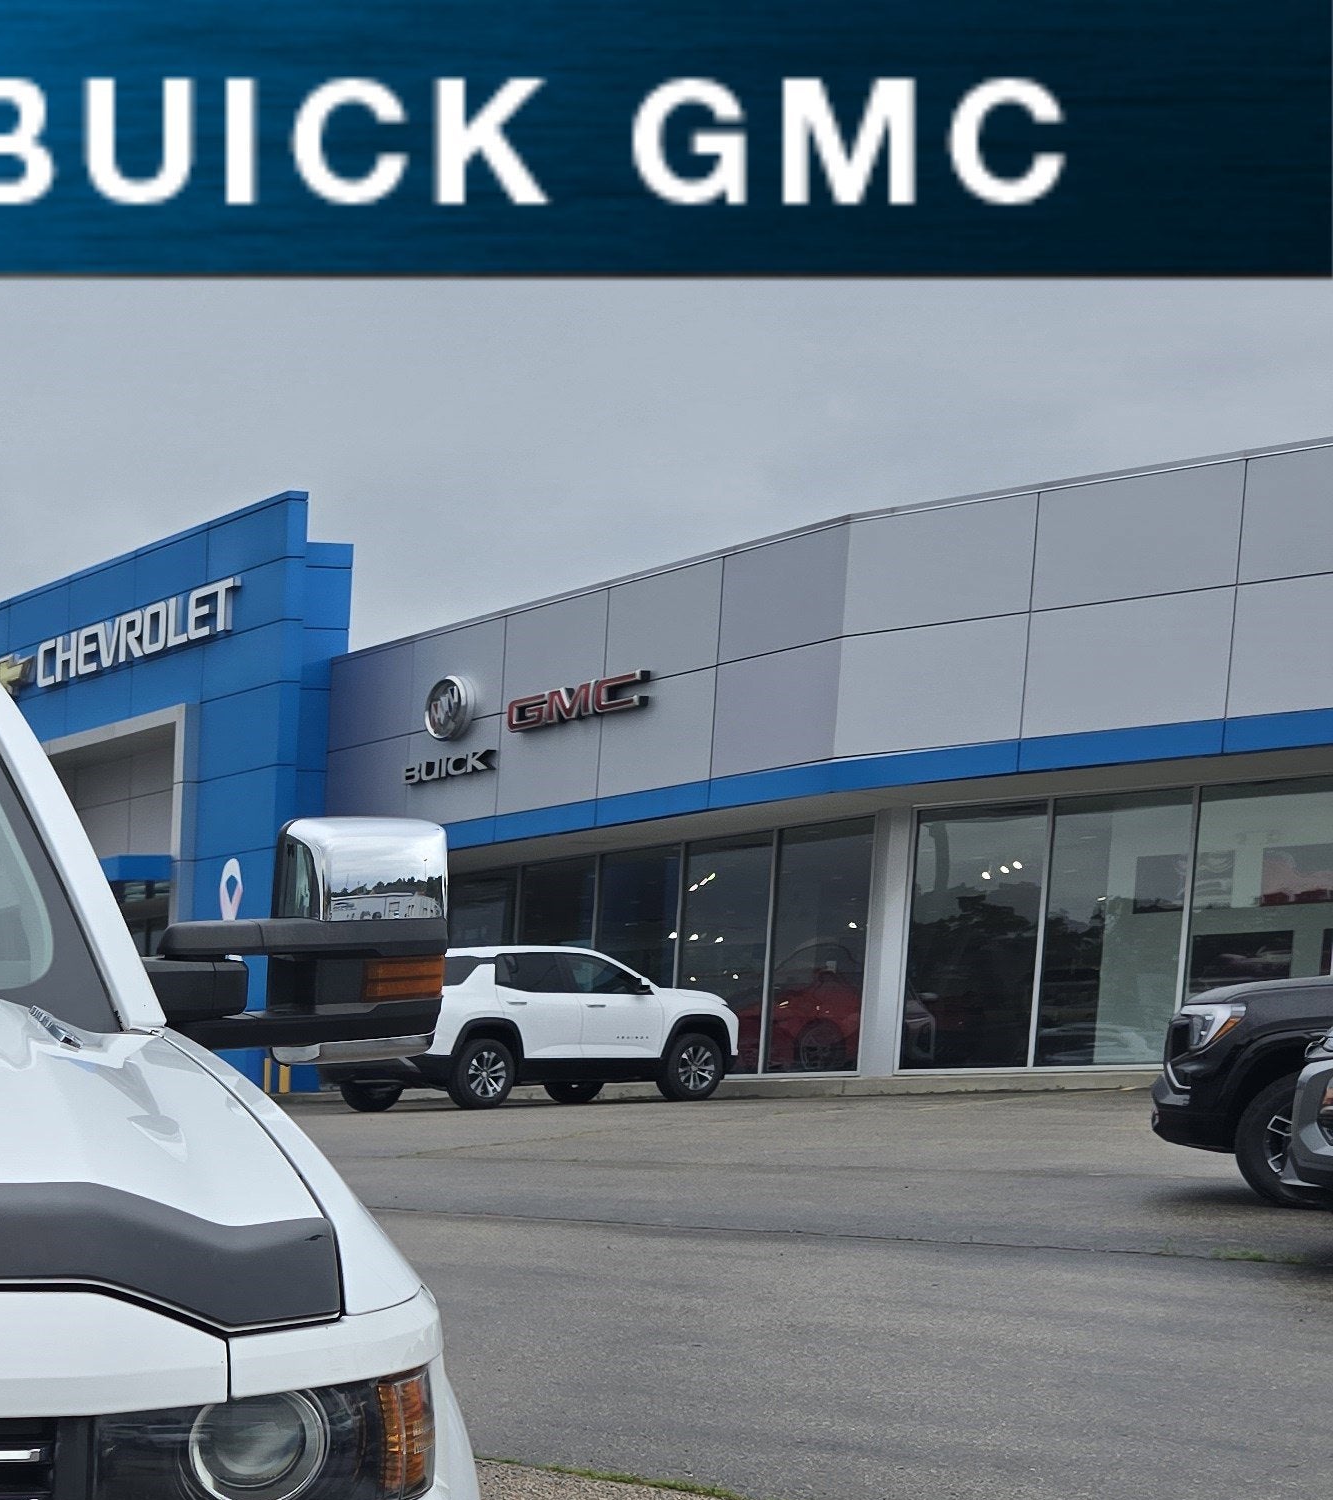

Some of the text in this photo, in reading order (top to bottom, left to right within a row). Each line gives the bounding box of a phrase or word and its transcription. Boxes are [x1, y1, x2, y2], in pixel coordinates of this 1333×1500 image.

[37, 576, 241, 688] CHEVROLET
[507, 669, 651, 733] GMC
[402, 749, 496, 785] BUICK
